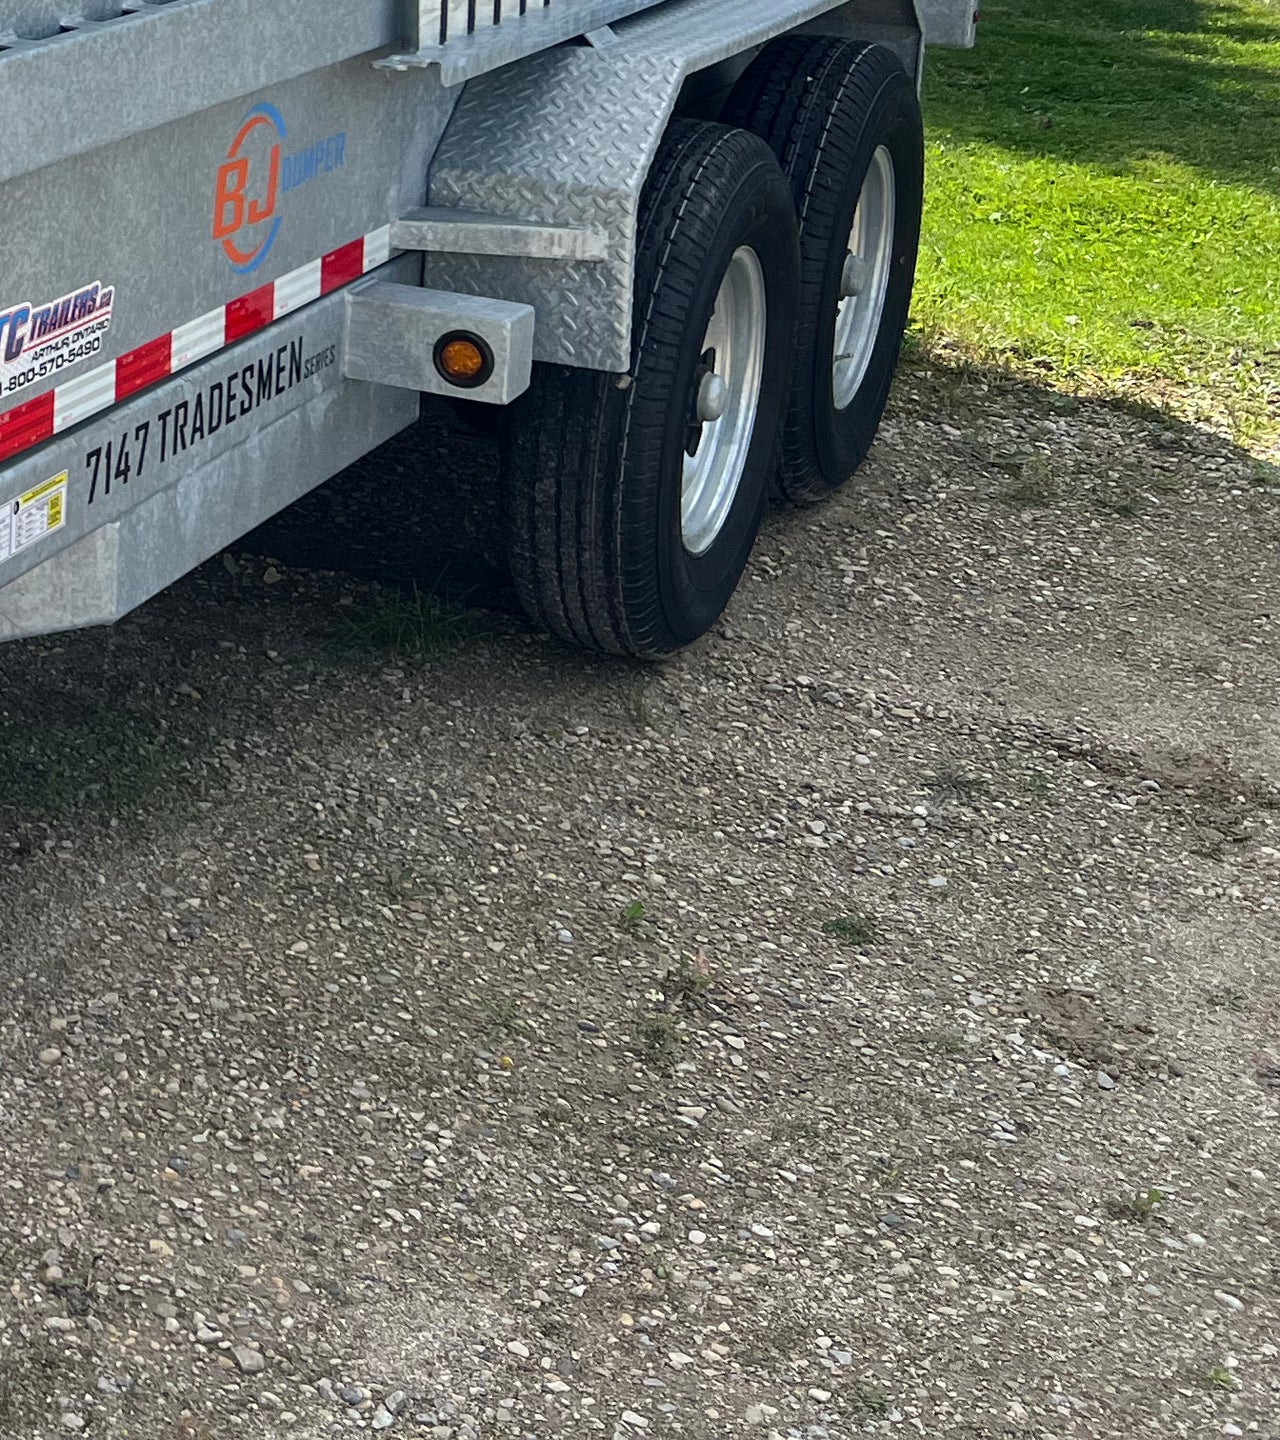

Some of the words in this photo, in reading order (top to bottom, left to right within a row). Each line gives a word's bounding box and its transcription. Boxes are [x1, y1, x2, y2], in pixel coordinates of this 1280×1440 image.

[212, 143, 281, 240] BJ
[282, 132, 347, 193] DUMPER
[71, 318, 110, 345] ONTARIO
[85, 420, 151, 505] 7147
[157, 335, 304, 464] TRADESMEN
[303, 344, 336, 379] SERIES
